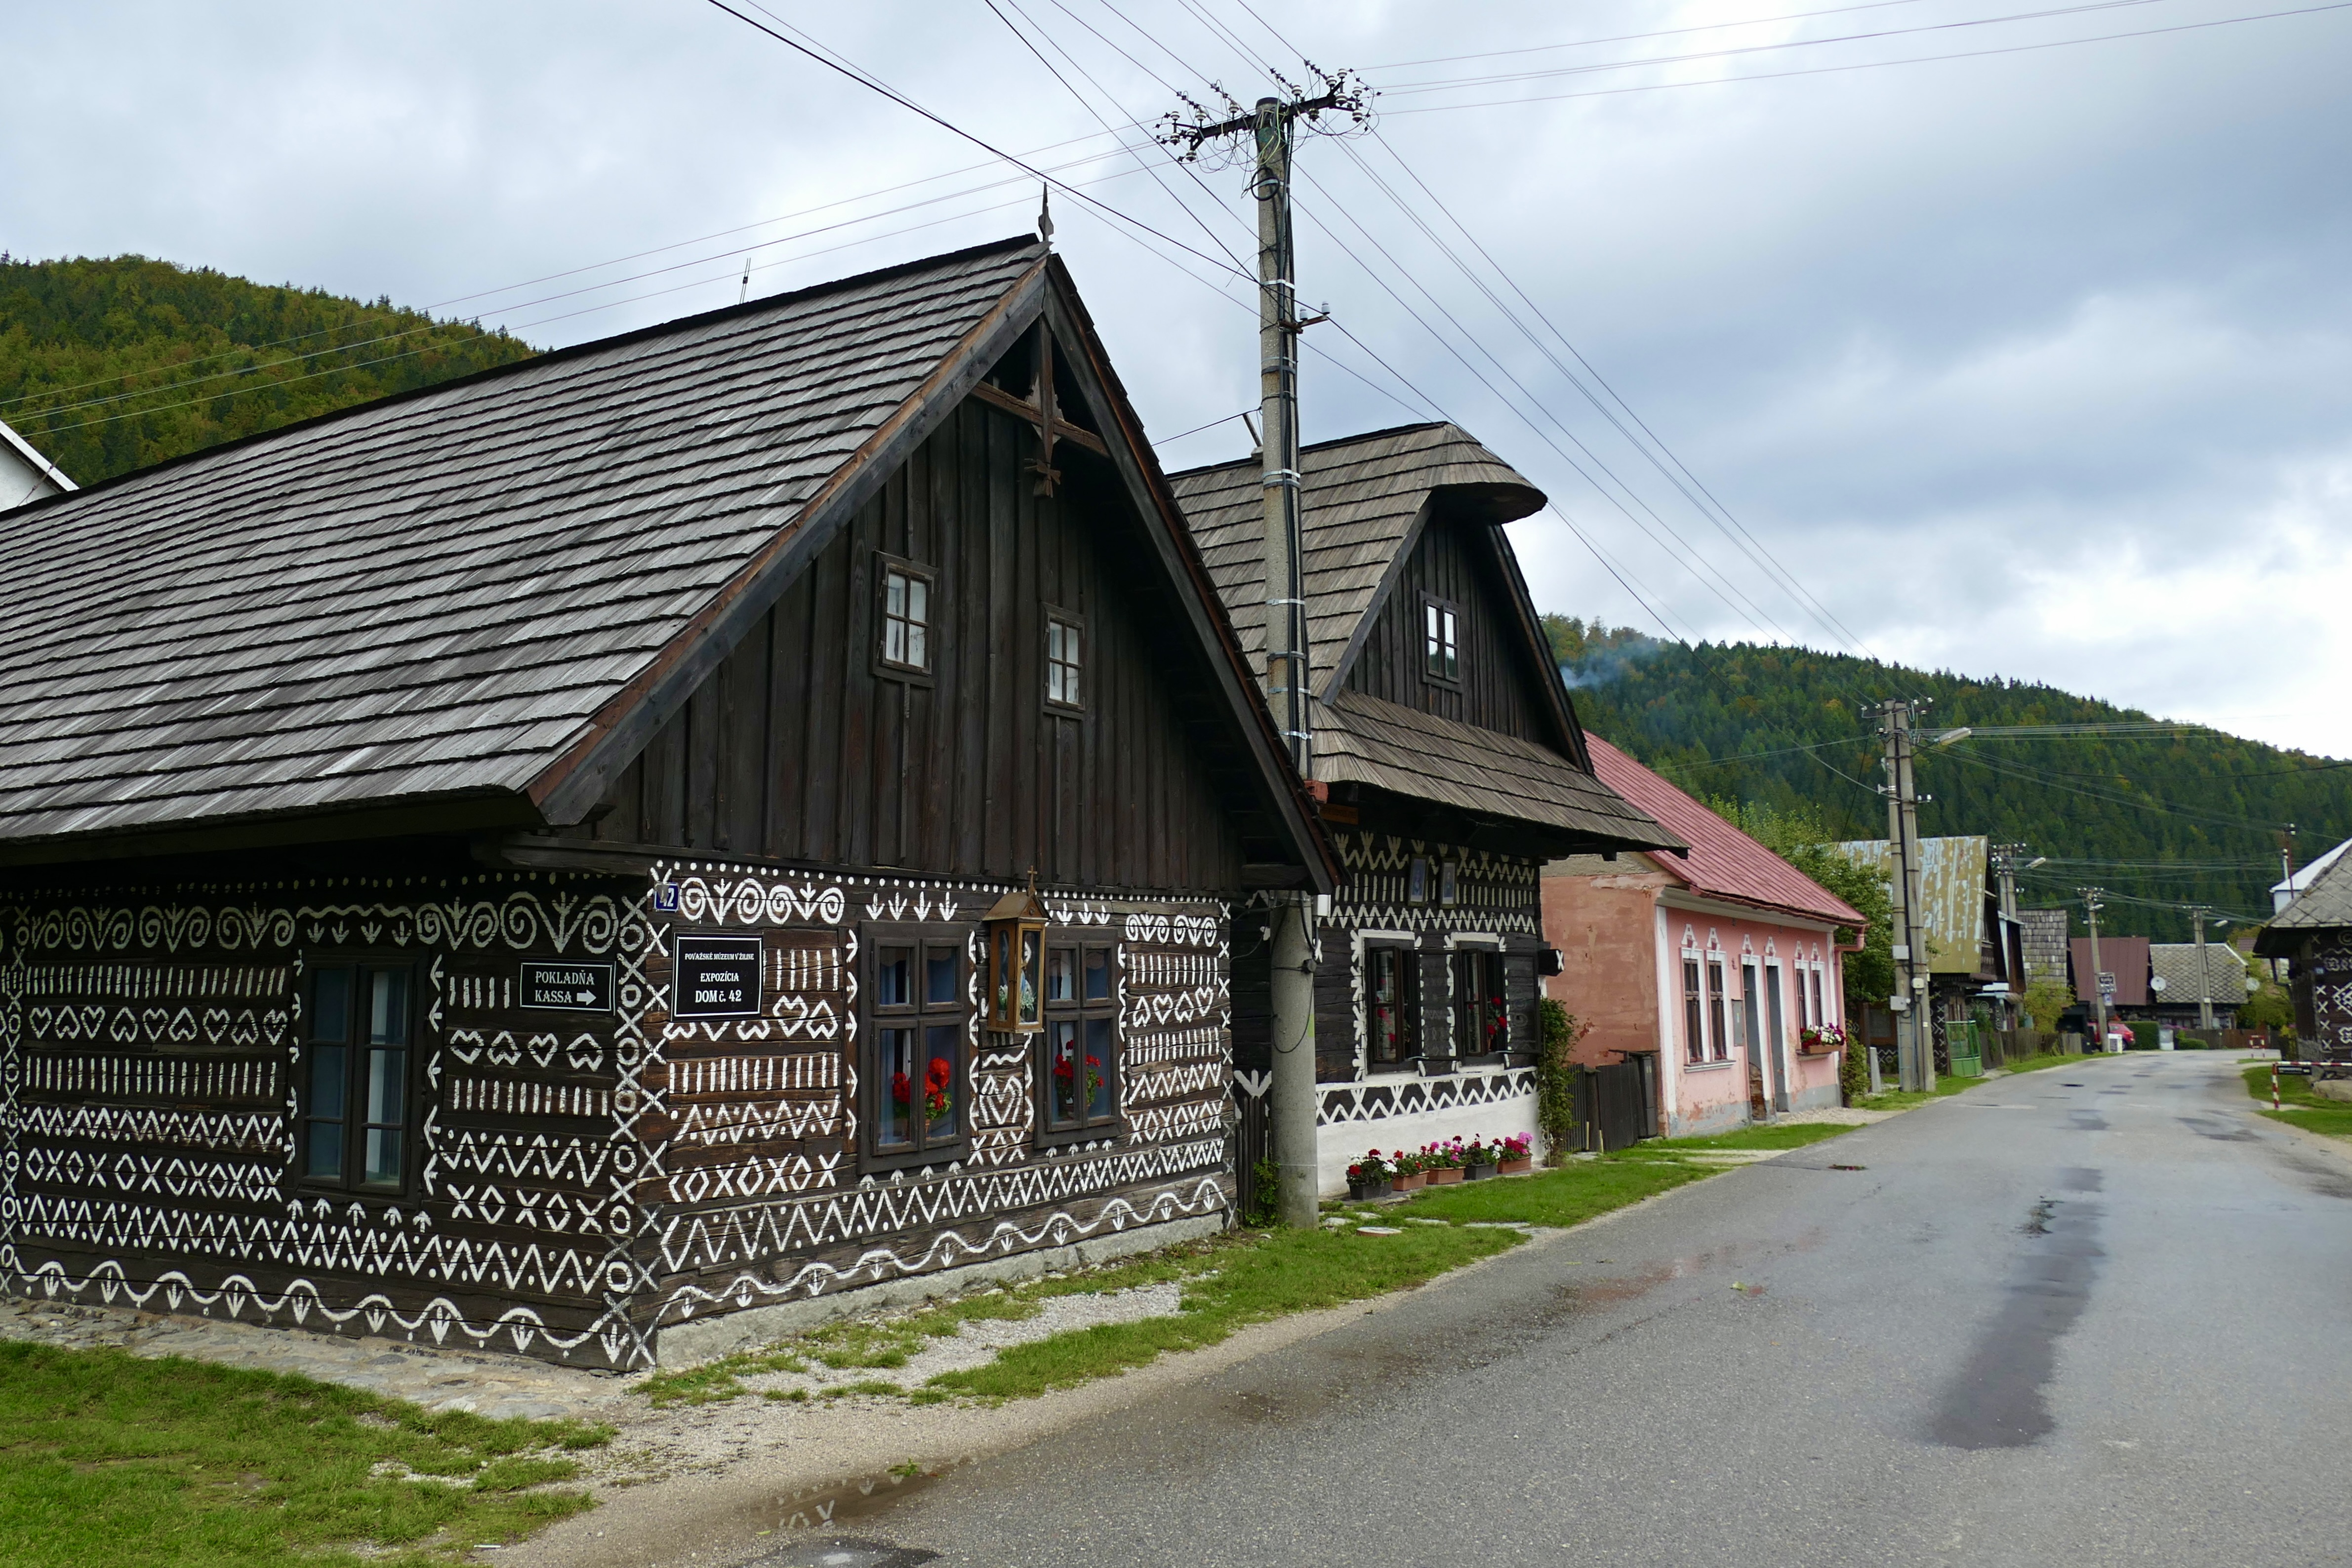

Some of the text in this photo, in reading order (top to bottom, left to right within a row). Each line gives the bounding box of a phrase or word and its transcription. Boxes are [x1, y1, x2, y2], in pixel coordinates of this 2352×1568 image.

[535, 969, 595, 985] POKLADŇA
[700, 970, 739, 982] EXPOZÍCIA
[534, 990, 573, 1004] KASSA
[695, 990, 718, 1003] DOM
[728, 989, 742, 1002] 42
